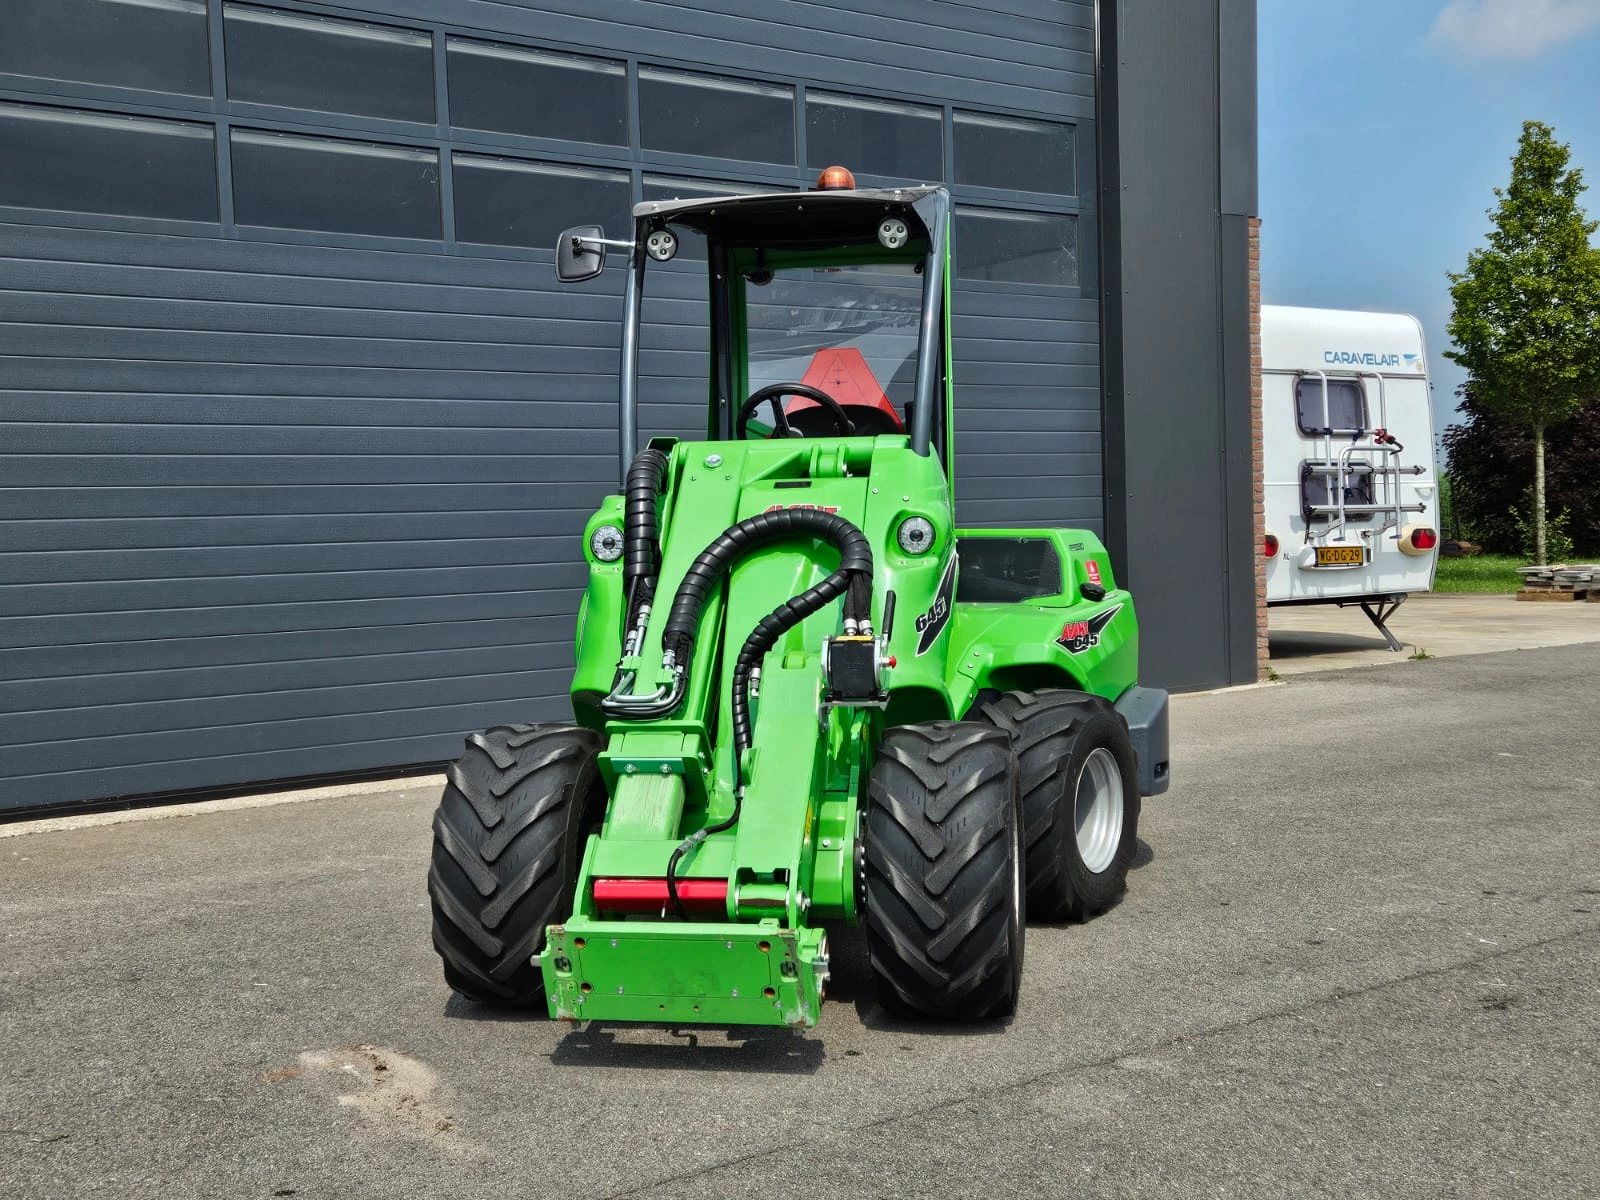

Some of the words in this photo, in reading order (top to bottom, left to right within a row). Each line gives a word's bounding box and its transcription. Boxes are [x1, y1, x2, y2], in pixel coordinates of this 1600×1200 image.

[1324, 351, 1400, 366] CARAVELAIR
[1319, 550, 1360, 562] WG-DG-29
[1074, 633, 1099, 649] 645
